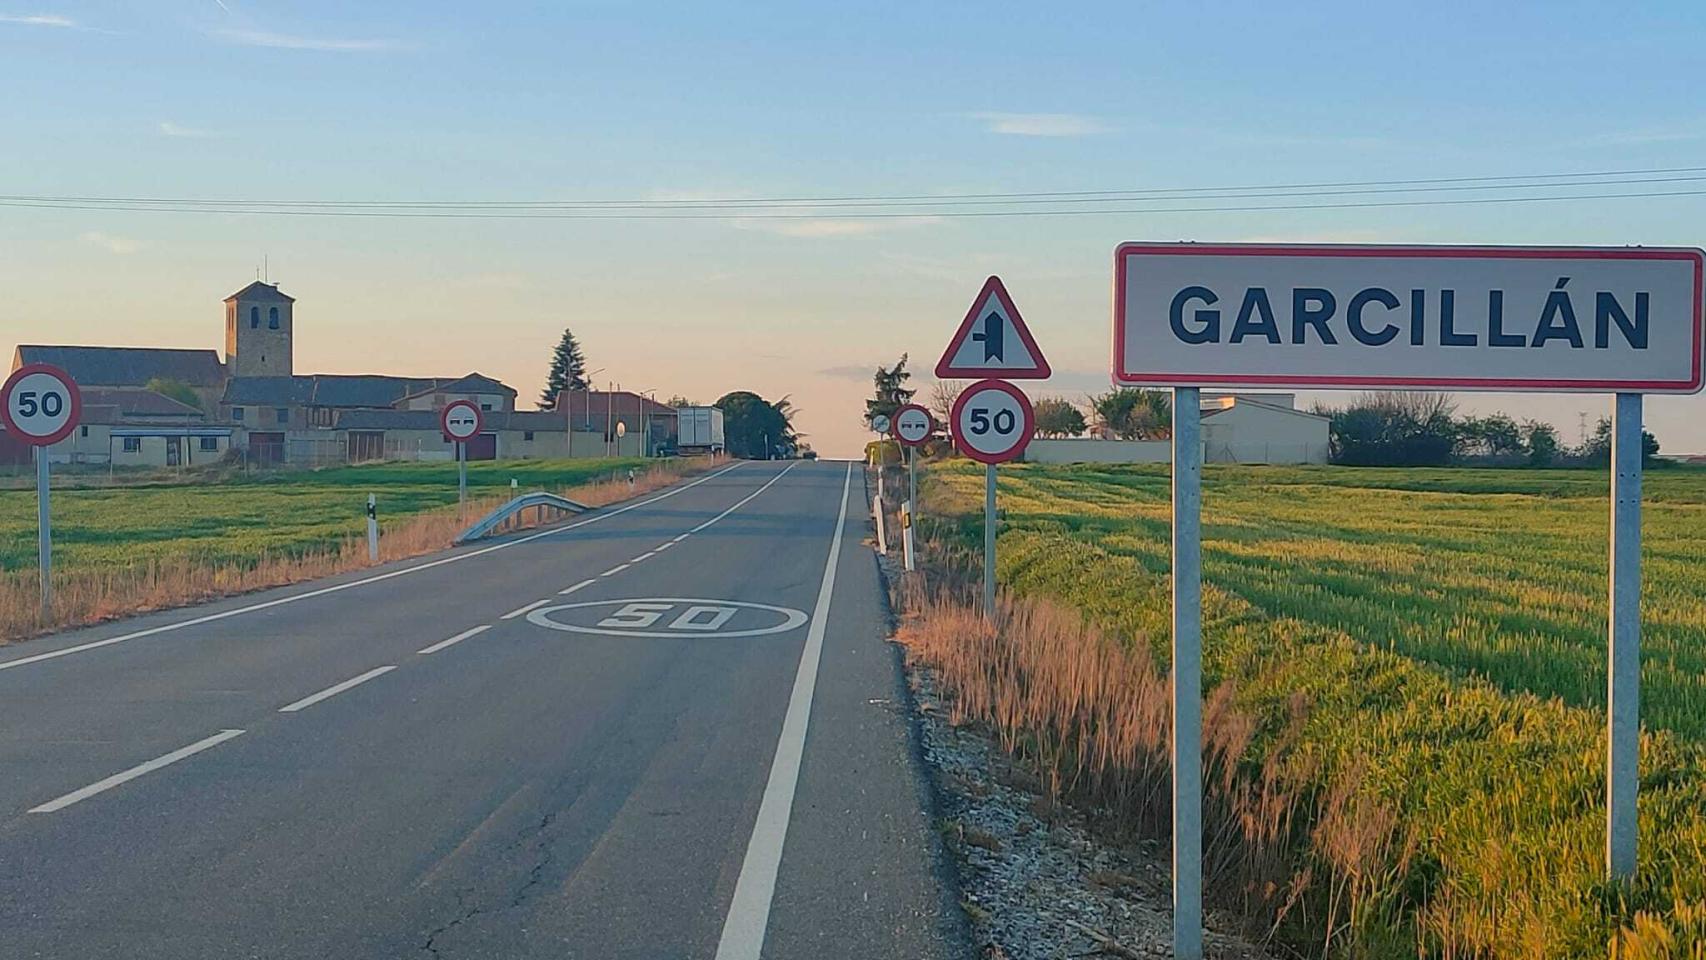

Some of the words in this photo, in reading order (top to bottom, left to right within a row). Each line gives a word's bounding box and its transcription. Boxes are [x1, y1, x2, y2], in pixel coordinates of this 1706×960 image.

[1169, 277, 1650, 350] GARCILLÁN
[18, 391, 62, 417] 50
[970, 408, 1015, 434] 50
[597, 603, 738, 630] 50
